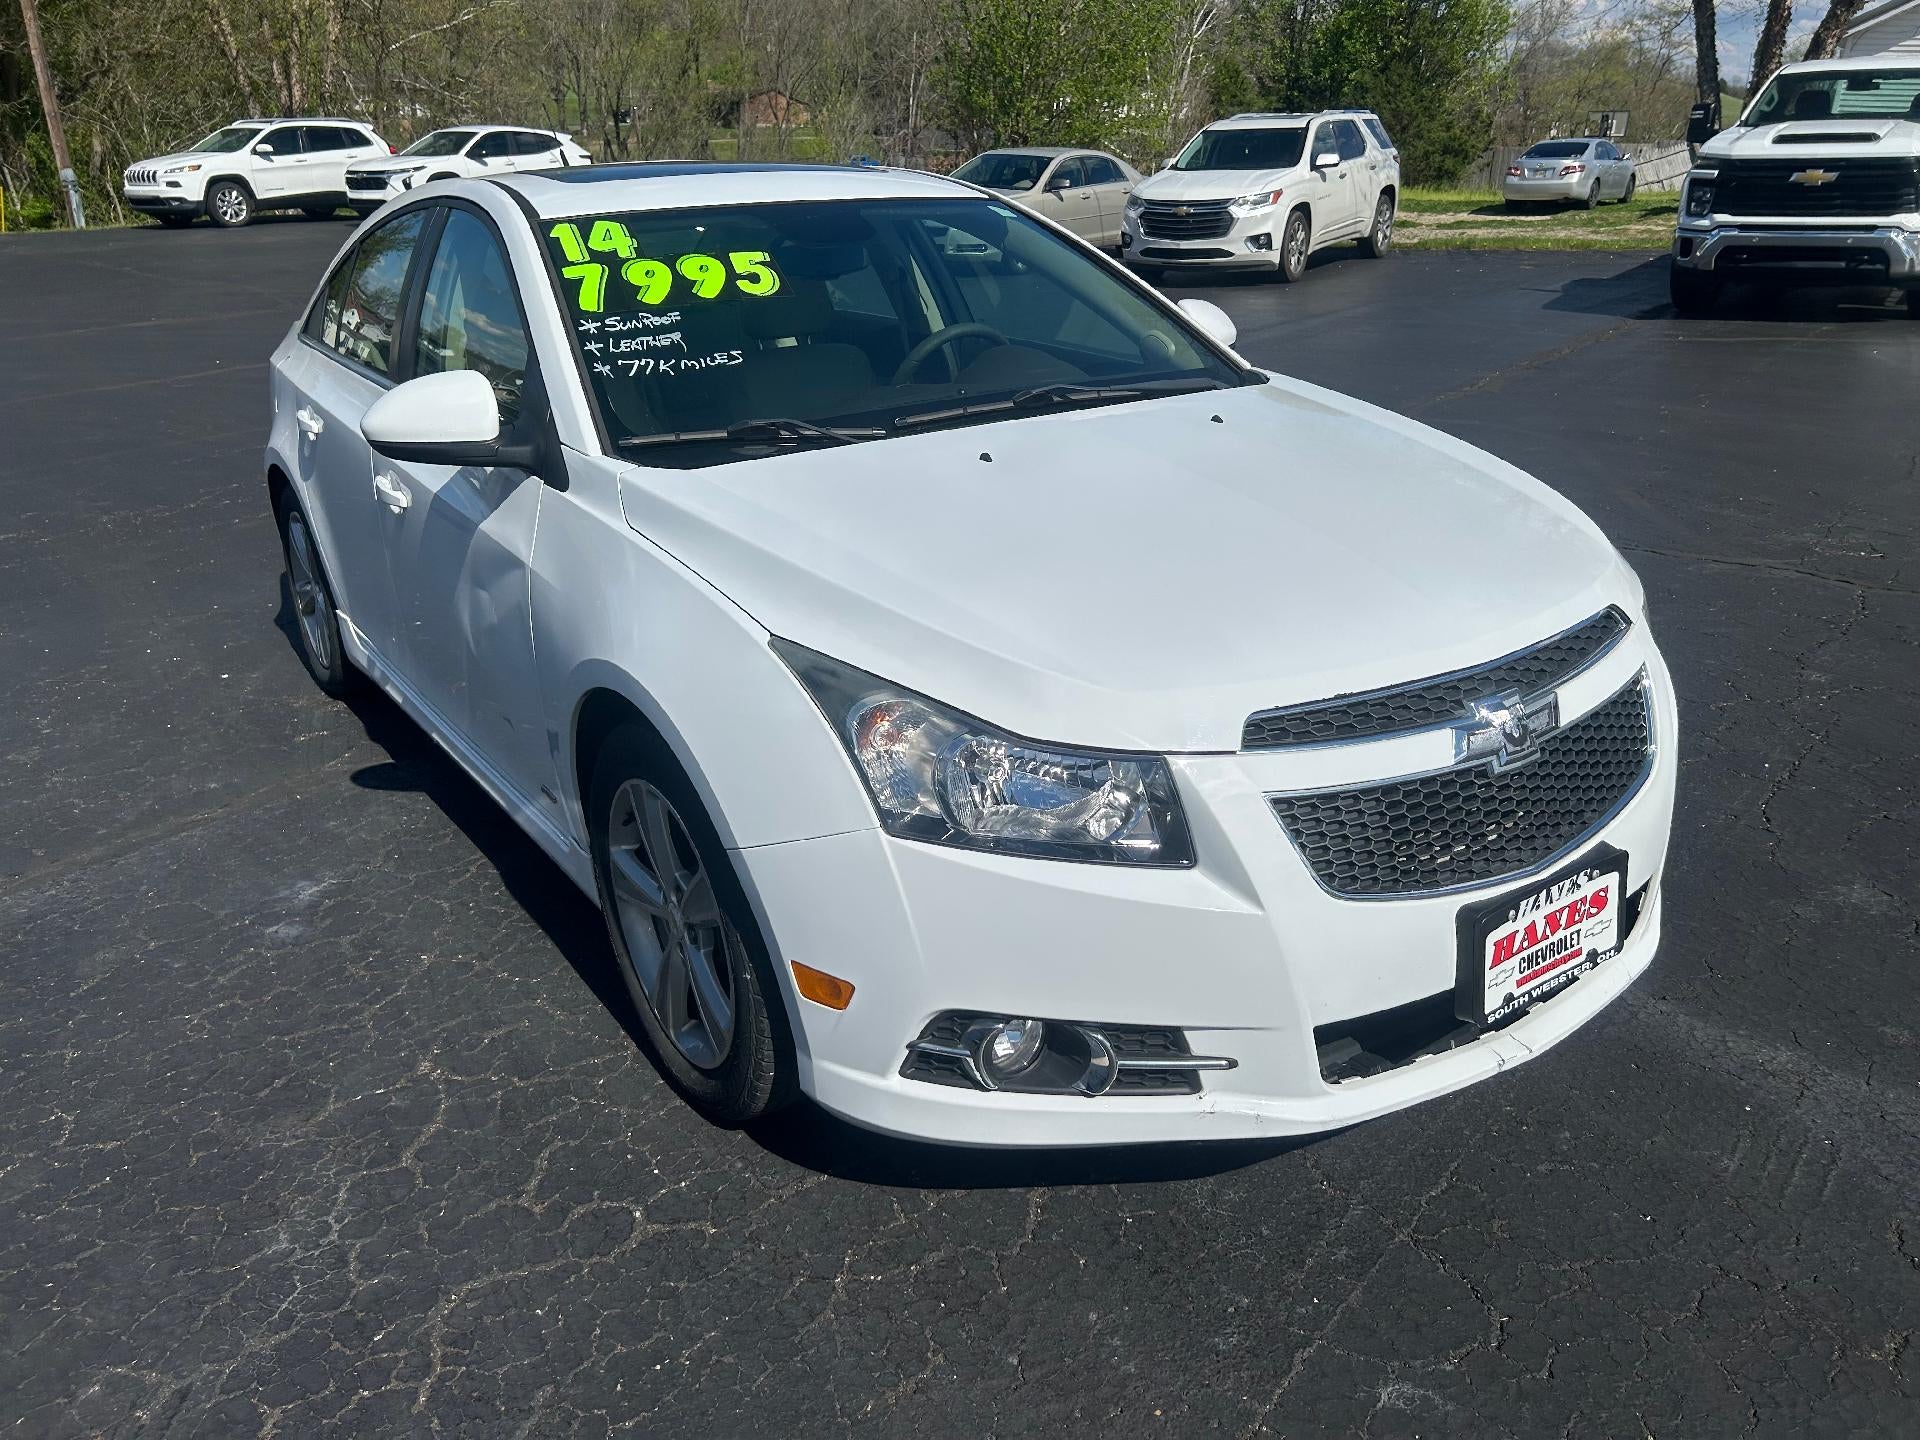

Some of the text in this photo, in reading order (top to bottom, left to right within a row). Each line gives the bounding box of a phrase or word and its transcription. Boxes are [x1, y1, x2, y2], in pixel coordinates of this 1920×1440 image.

[550, 220, 637, 262] 14
[562, 251, 780, 312] 7995
[609, 331, 687, 352] LEATHER
[1489, 885, 1609, 970] HANES
[1518, 929, 1582, 974] CHEVROLET
[1487, 994, 1529, 1023] SOUTH
